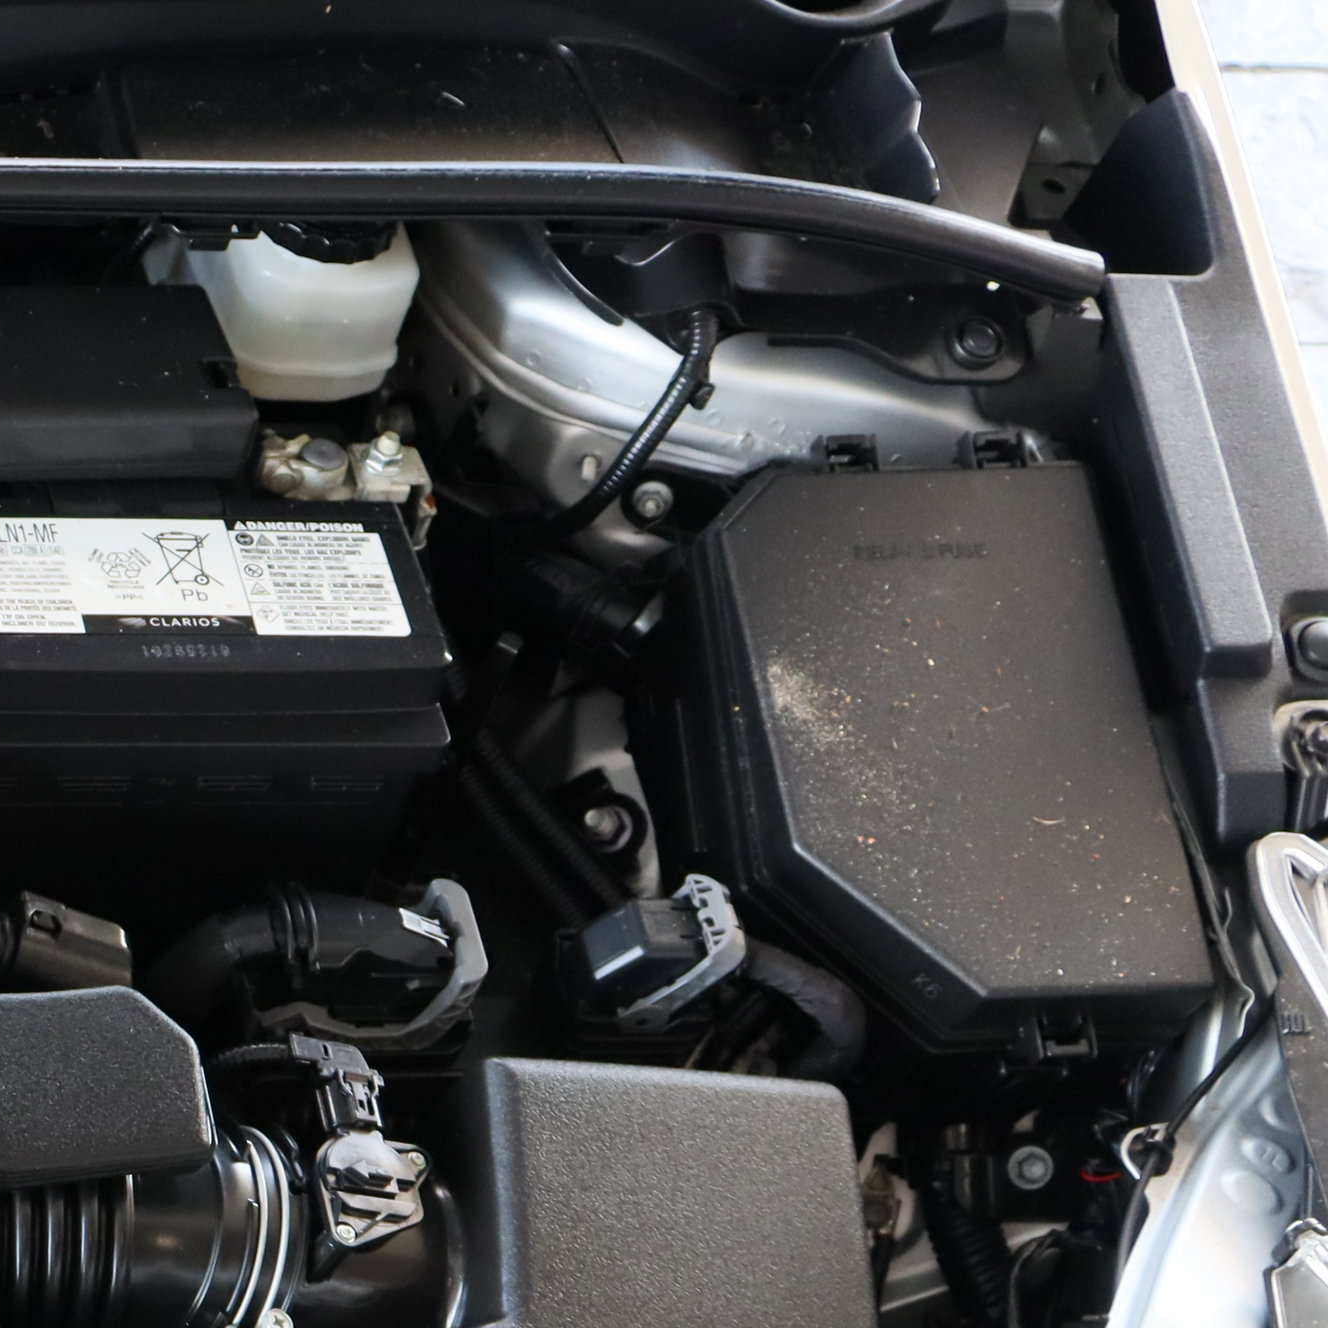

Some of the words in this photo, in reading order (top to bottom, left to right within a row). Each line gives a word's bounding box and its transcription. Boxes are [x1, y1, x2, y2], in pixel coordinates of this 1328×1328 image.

[246, 521, 364, 532] DANGER/POISON
[181, 588, 209, 602] Pb
[149, 617, 221, 627] CLARIOS
